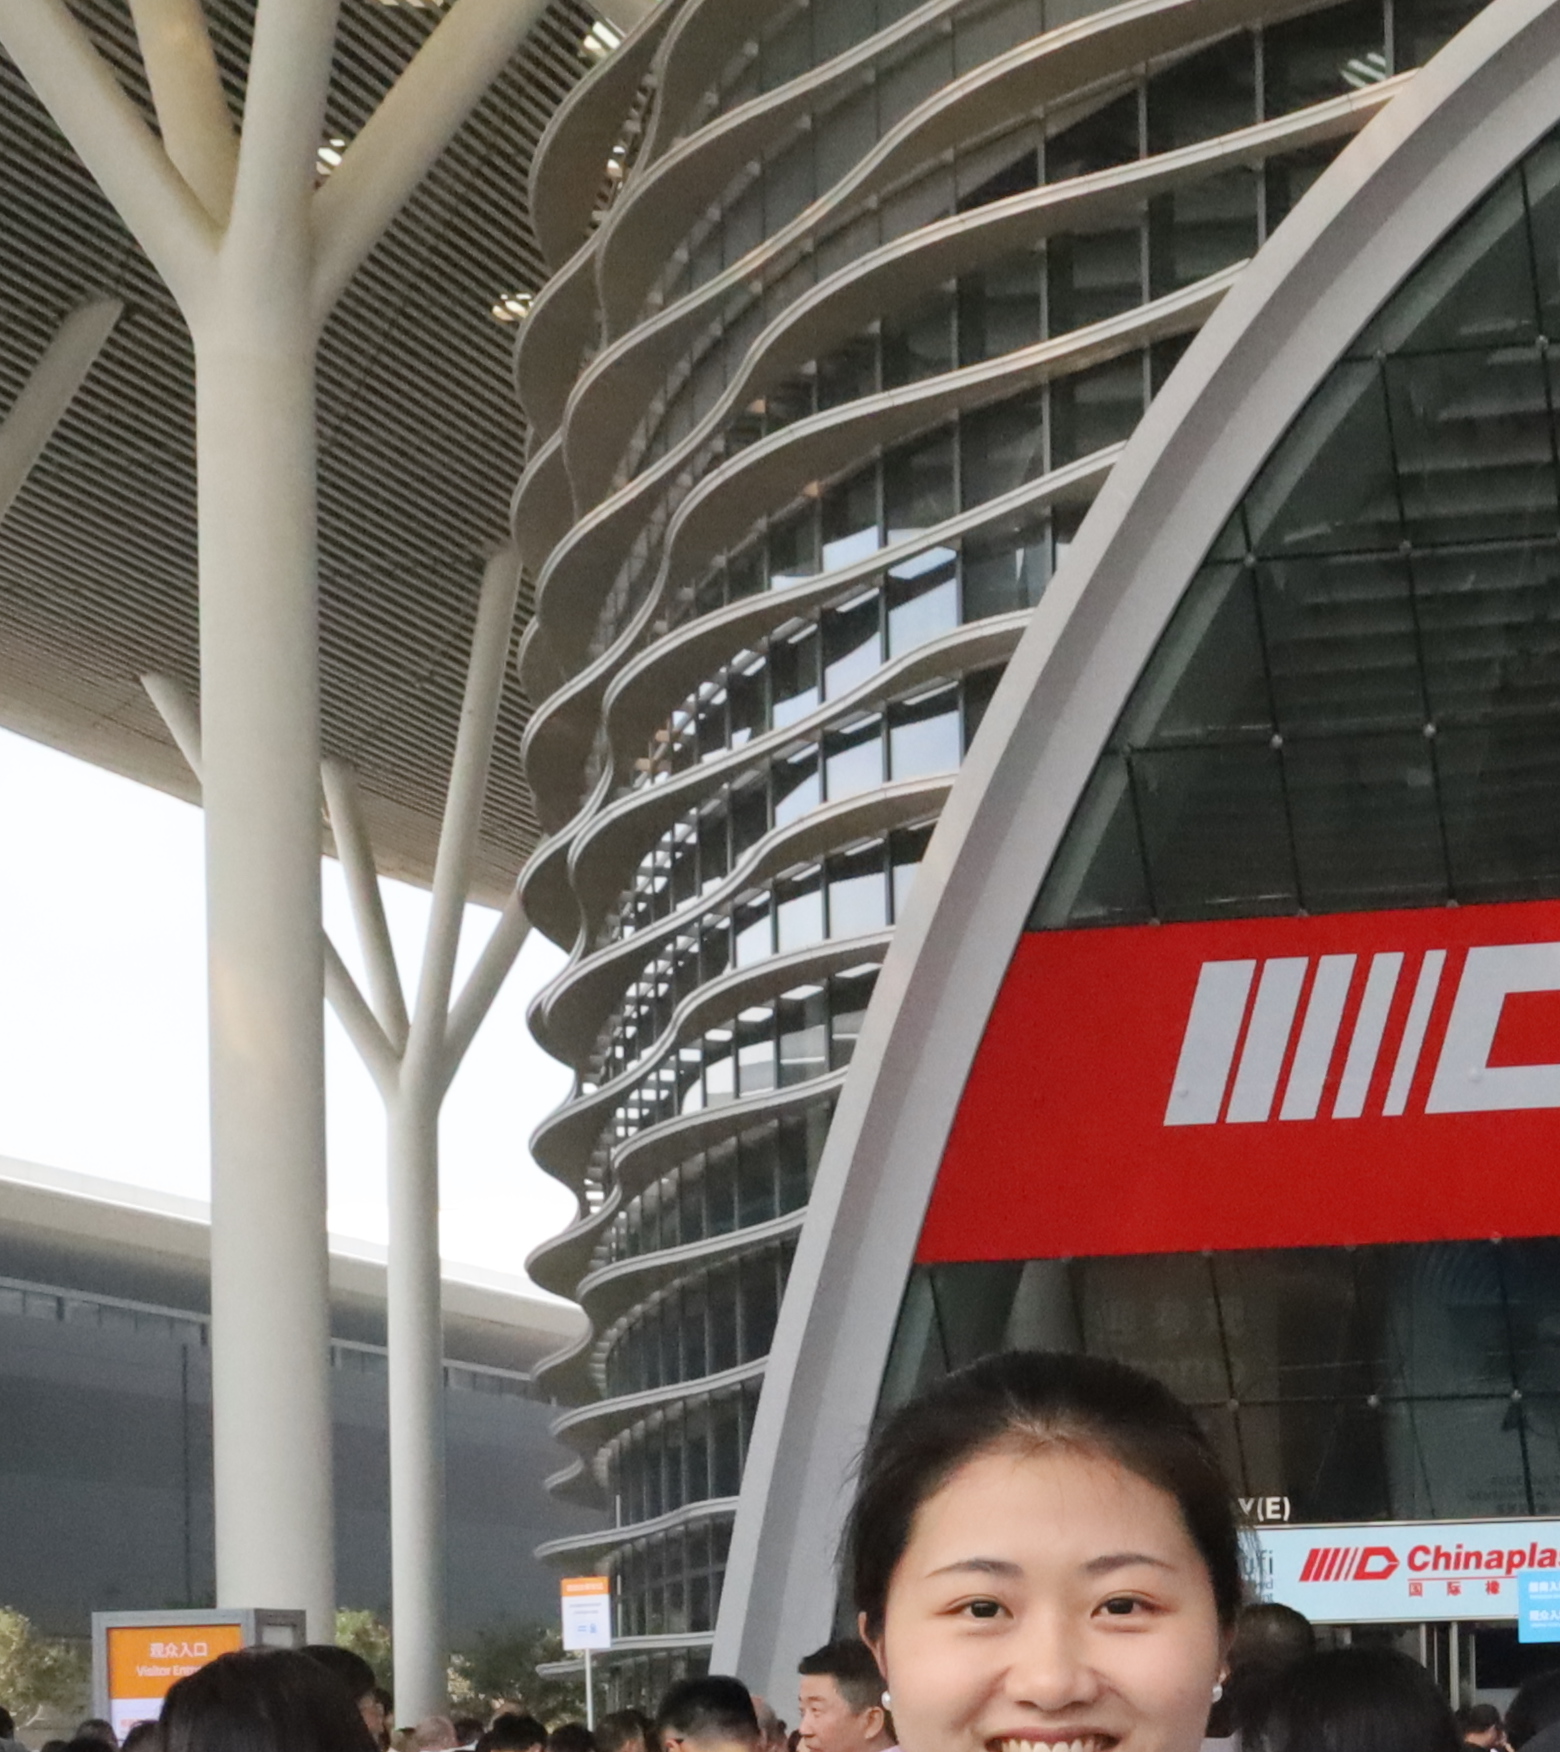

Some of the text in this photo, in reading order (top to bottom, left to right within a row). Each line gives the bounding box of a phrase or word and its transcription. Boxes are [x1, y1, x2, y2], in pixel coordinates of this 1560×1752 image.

[1408, 1579, 1501, 1599] 国际橡
[148, 1642, 209, 1659] 观众入口
[136, 1665, 172, 1677] Visitor
